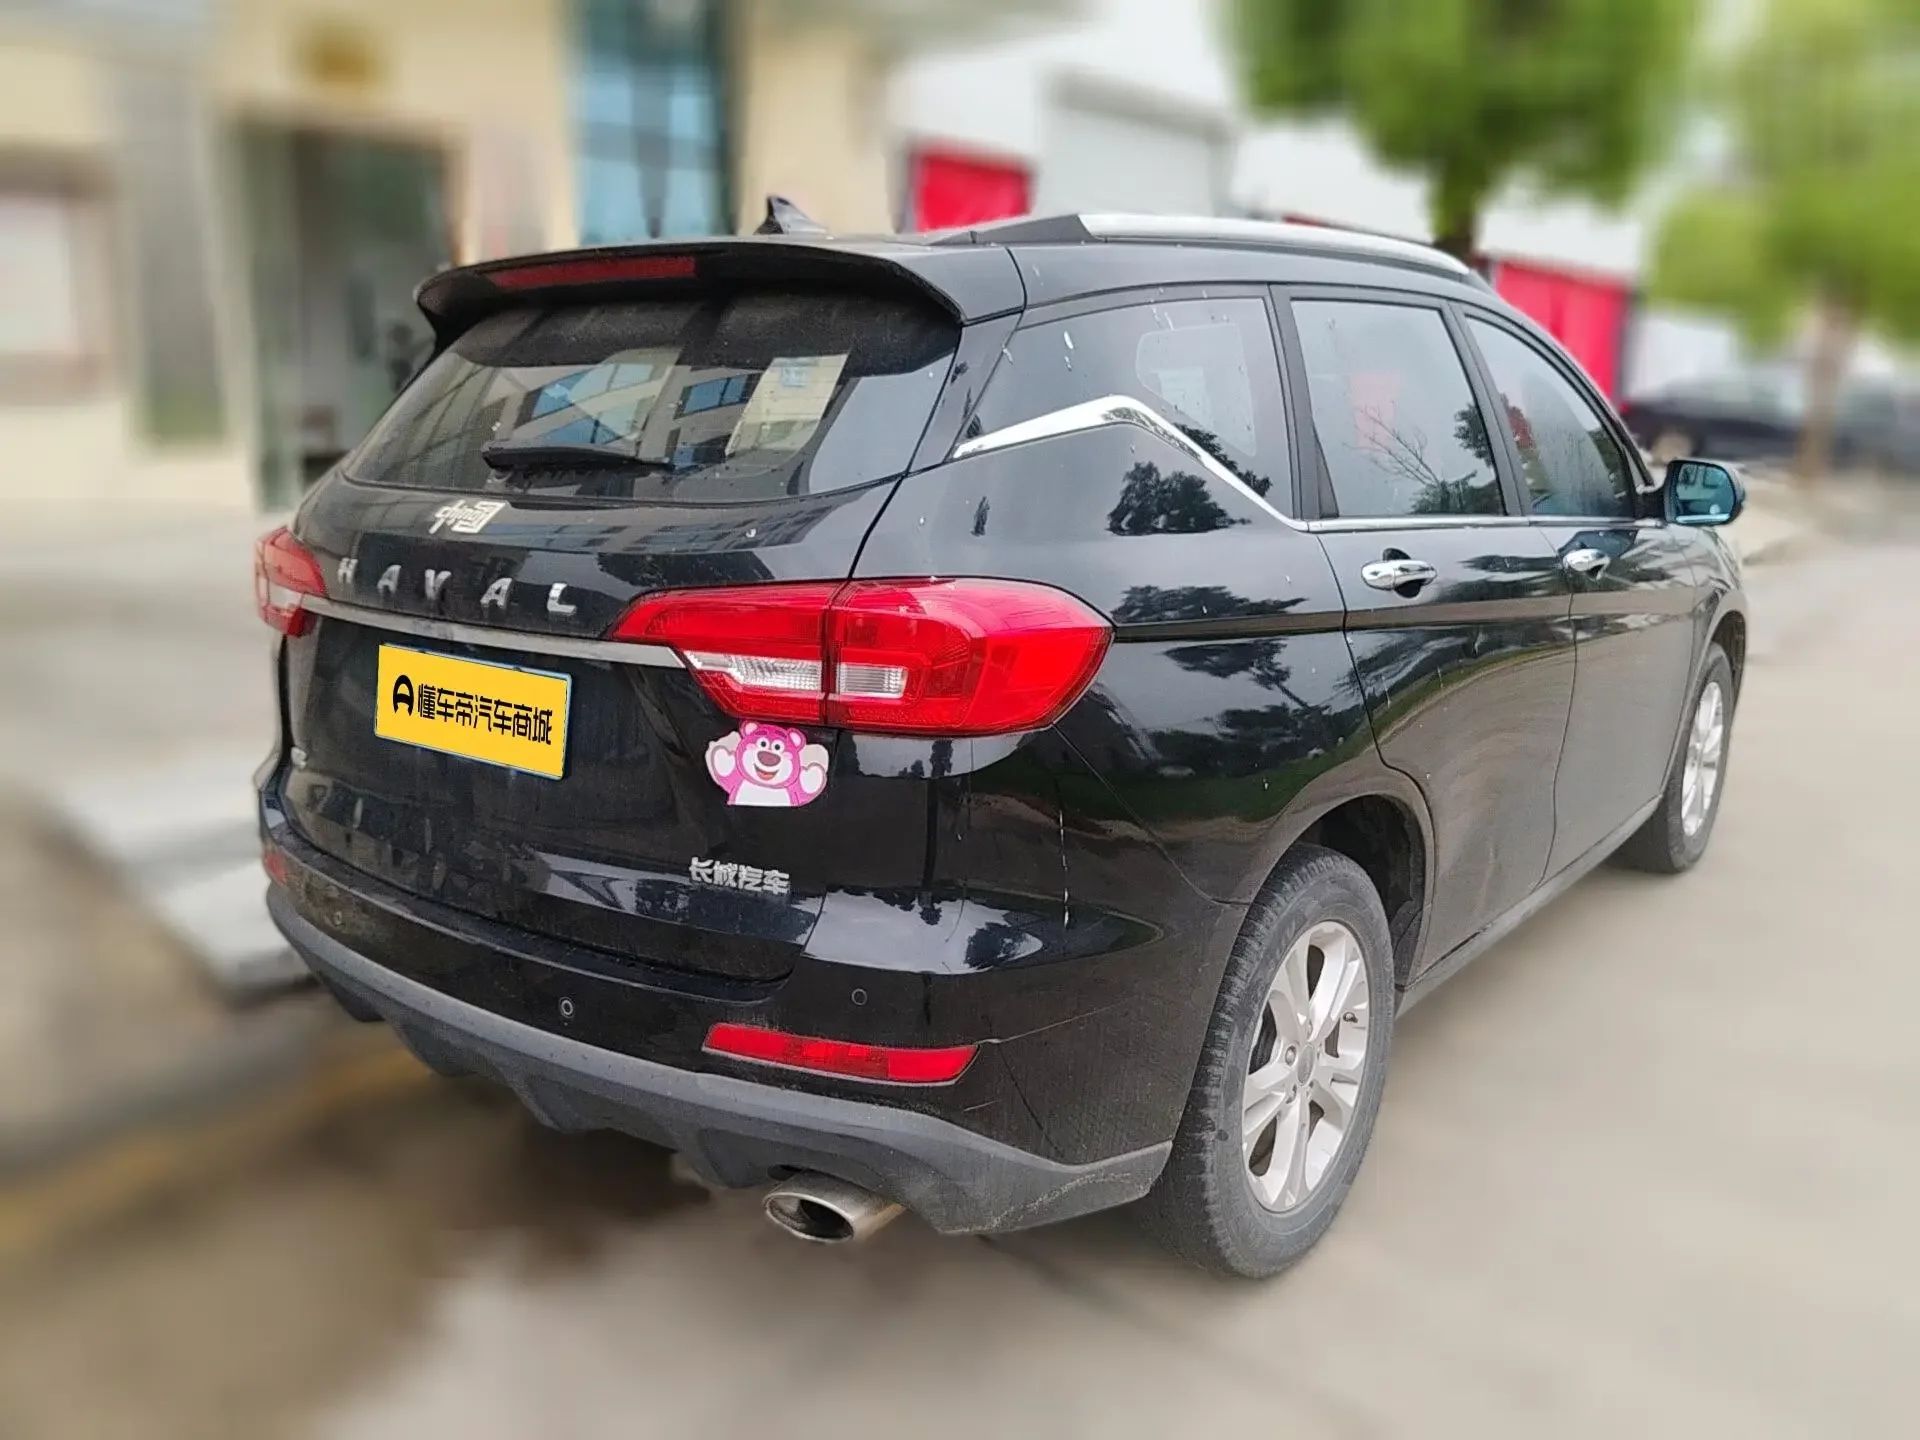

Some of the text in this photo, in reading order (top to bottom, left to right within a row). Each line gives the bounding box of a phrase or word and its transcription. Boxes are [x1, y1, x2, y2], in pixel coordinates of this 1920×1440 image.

[337, 557, 577, 616] HAVAL
[689, 857, 790, 894] 长城汽车
